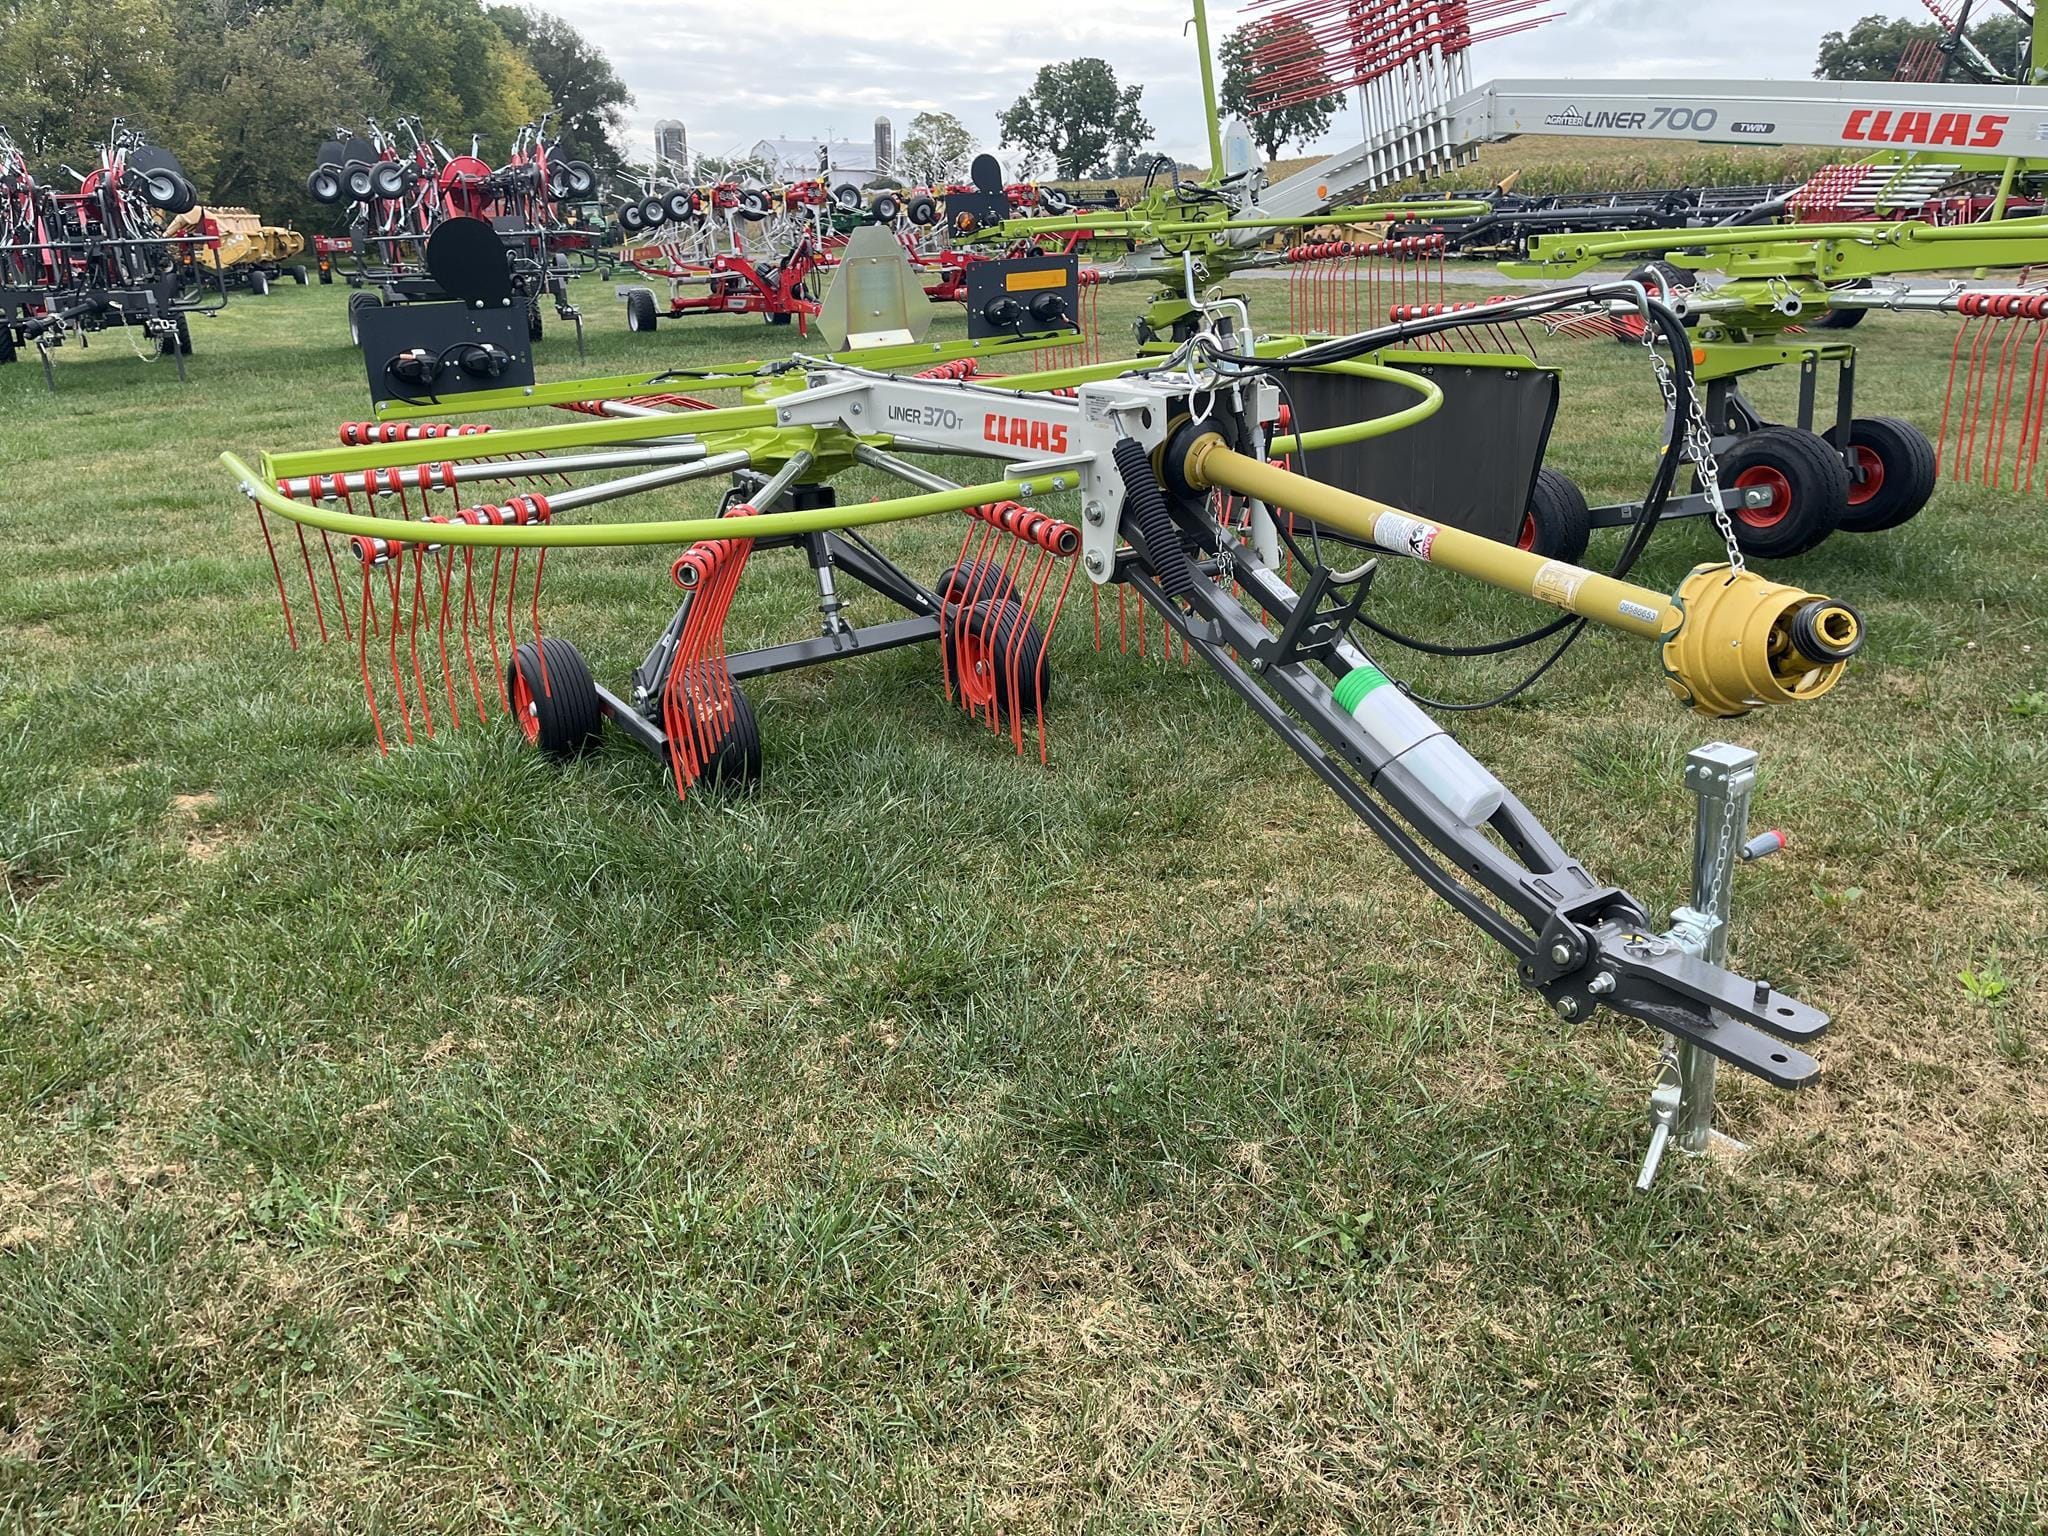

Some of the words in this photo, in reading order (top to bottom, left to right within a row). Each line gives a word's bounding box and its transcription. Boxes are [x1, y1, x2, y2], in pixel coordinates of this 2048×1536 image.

[1545, 114, 1584, 127] AGRITEER
[1584, 111, 1646, 129] LINER
[1648, 107, 1718, 131] 700
[1740, 123, 1767, 132] TWIN
[1841, 110, 2010, 148] CLAAS
[888, 405, 921, 424] LINER
[984, 413, 1068, 454] CLAAS
